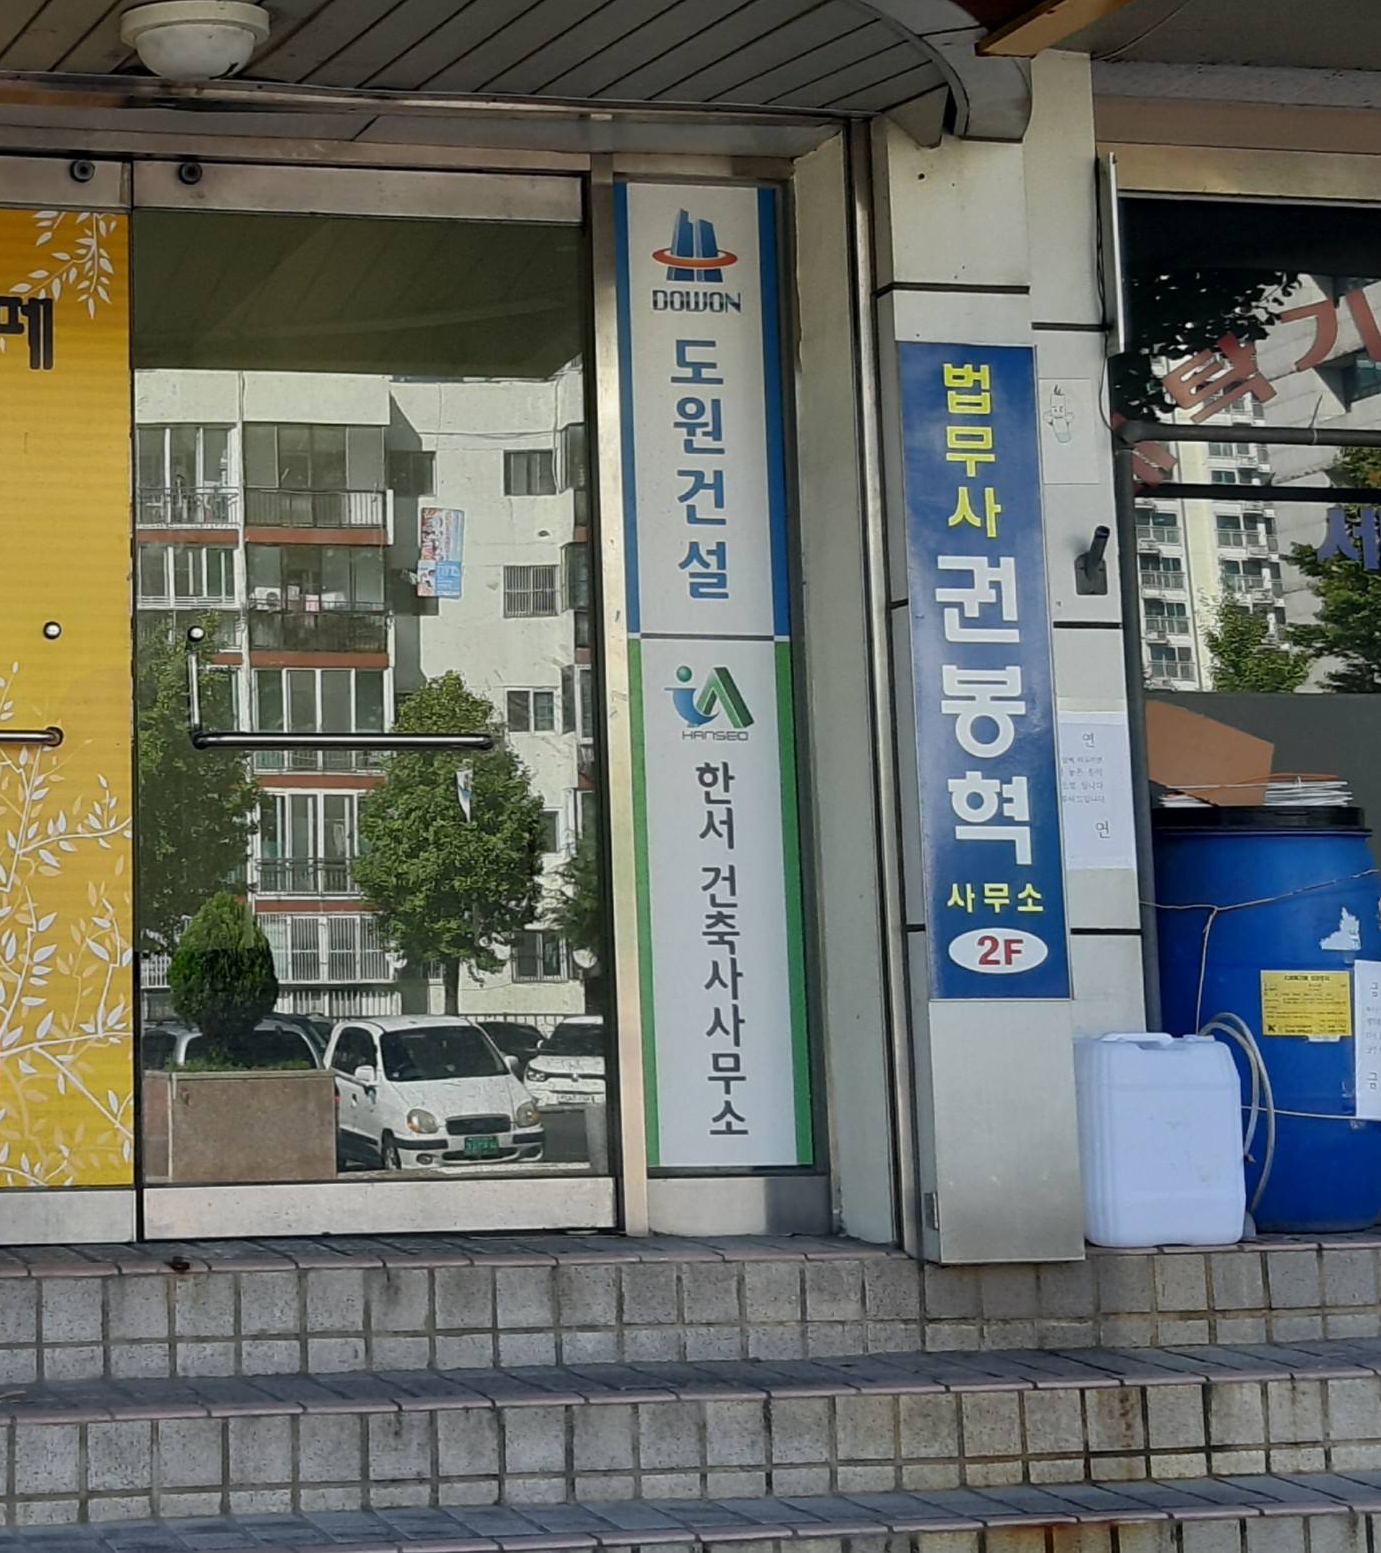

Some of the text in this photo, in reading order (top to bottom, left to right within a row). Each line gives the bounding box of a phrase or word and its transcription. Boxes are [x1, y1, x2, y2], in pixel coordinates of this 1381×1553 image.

[651, 289, 742, 314] DOWON
[669, 338, 731, 601] 도원건설
[942, 362, 1004, 539] 법무사
[934, 554, 1033, 866] 권봉혁
[1082, 732, 1095, 749] 연
[694, 760, 750, 1138] 한서 건축사사무소
[946, 882, 1044, 913] 사무소
[977, 934, 1024, 966] 2F
